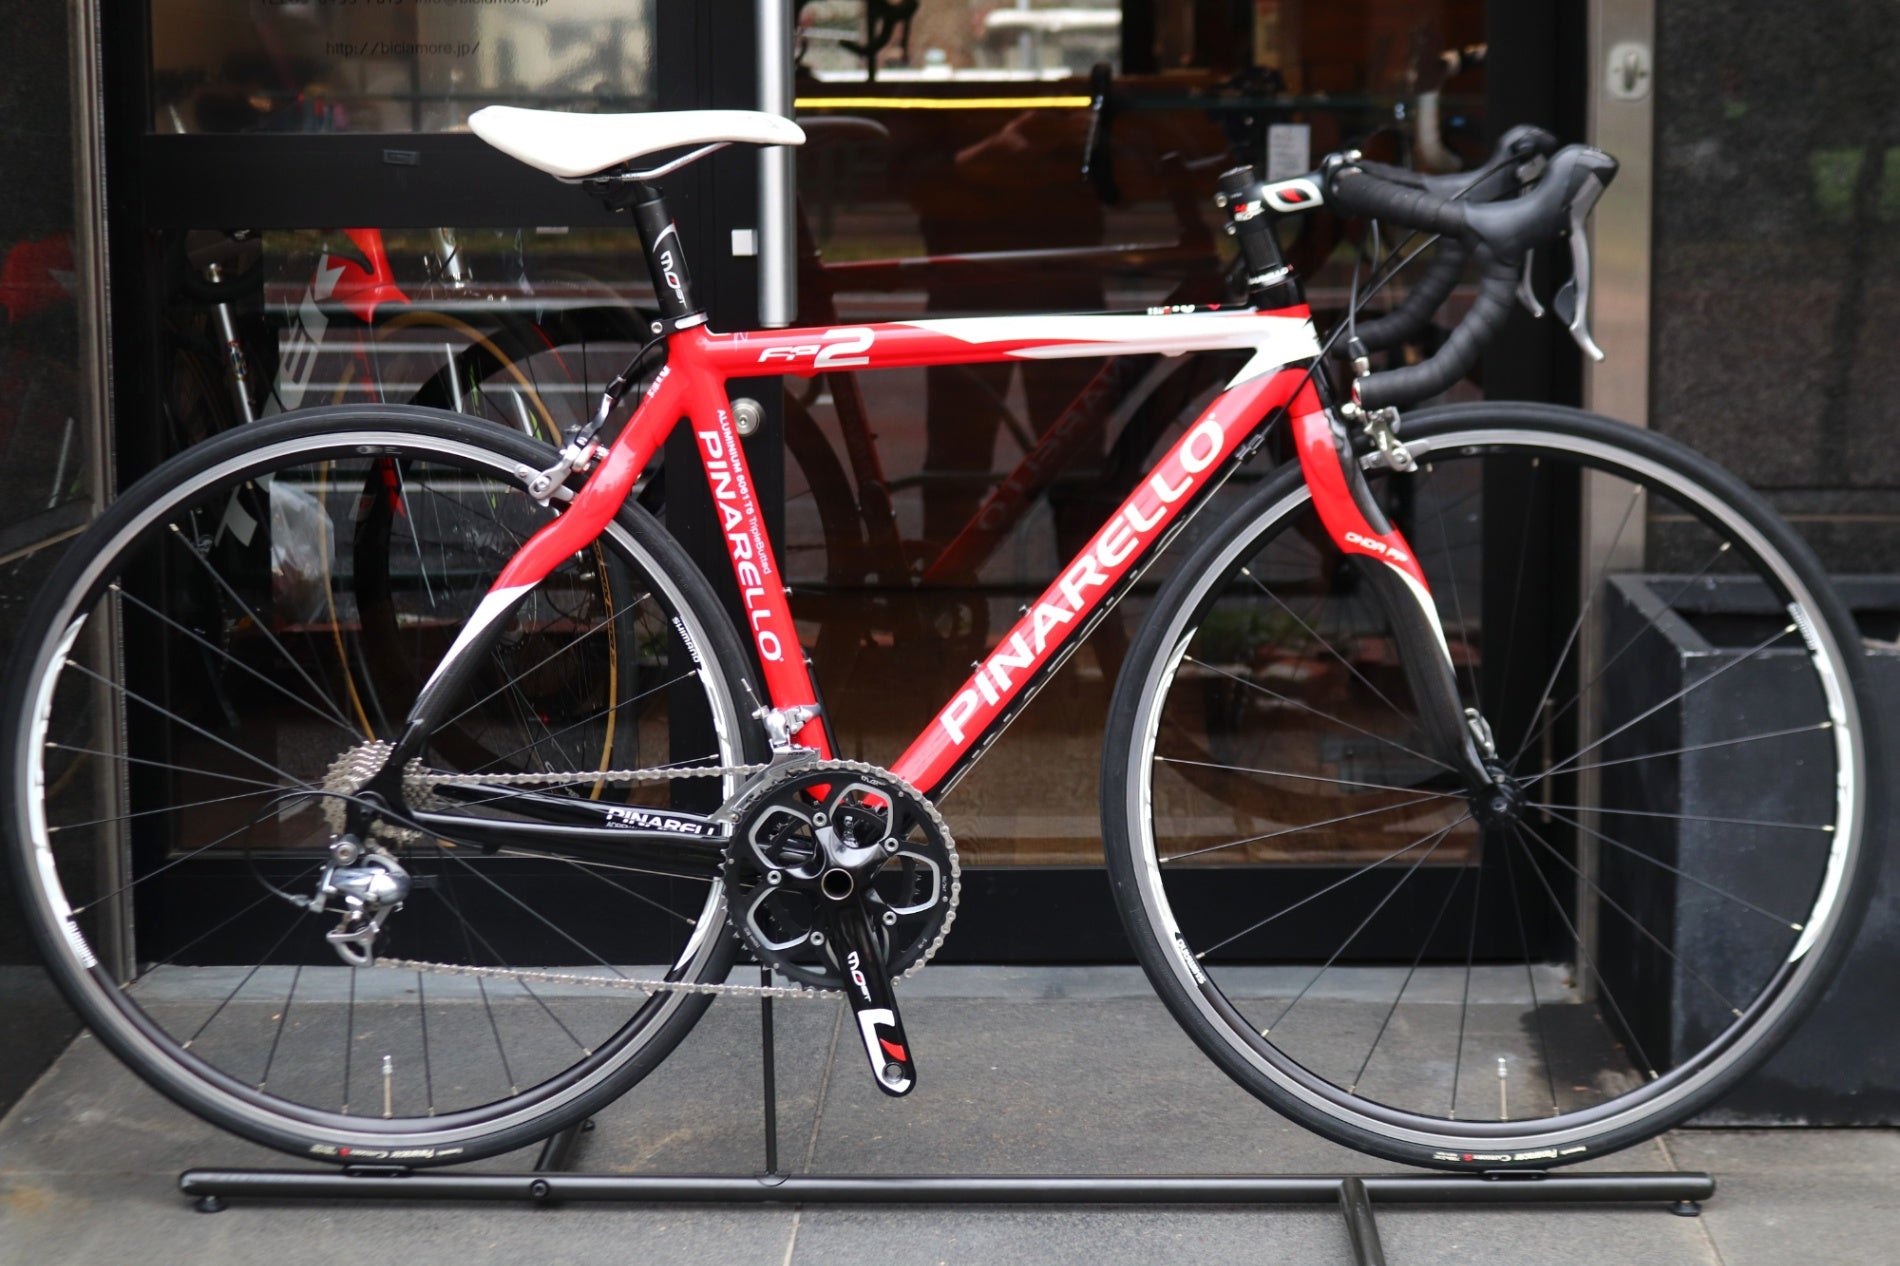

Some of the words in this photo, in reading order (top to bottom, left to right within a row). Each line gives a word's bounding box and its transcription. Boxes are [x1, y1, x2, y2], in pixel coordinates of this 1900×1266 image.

[326, 41, 480, 57] http://biciamore.jp/
[717, 409, 743, 473] ALUMINIUM
[736, 474, 751, 501] 6061
[744, 500, 755, 515] T6
[698, 430, 784, 662] PINARELLO
[939, 417, 1225, 746] PINARELLO
[672, 616, 701, 663] SHIMANO
